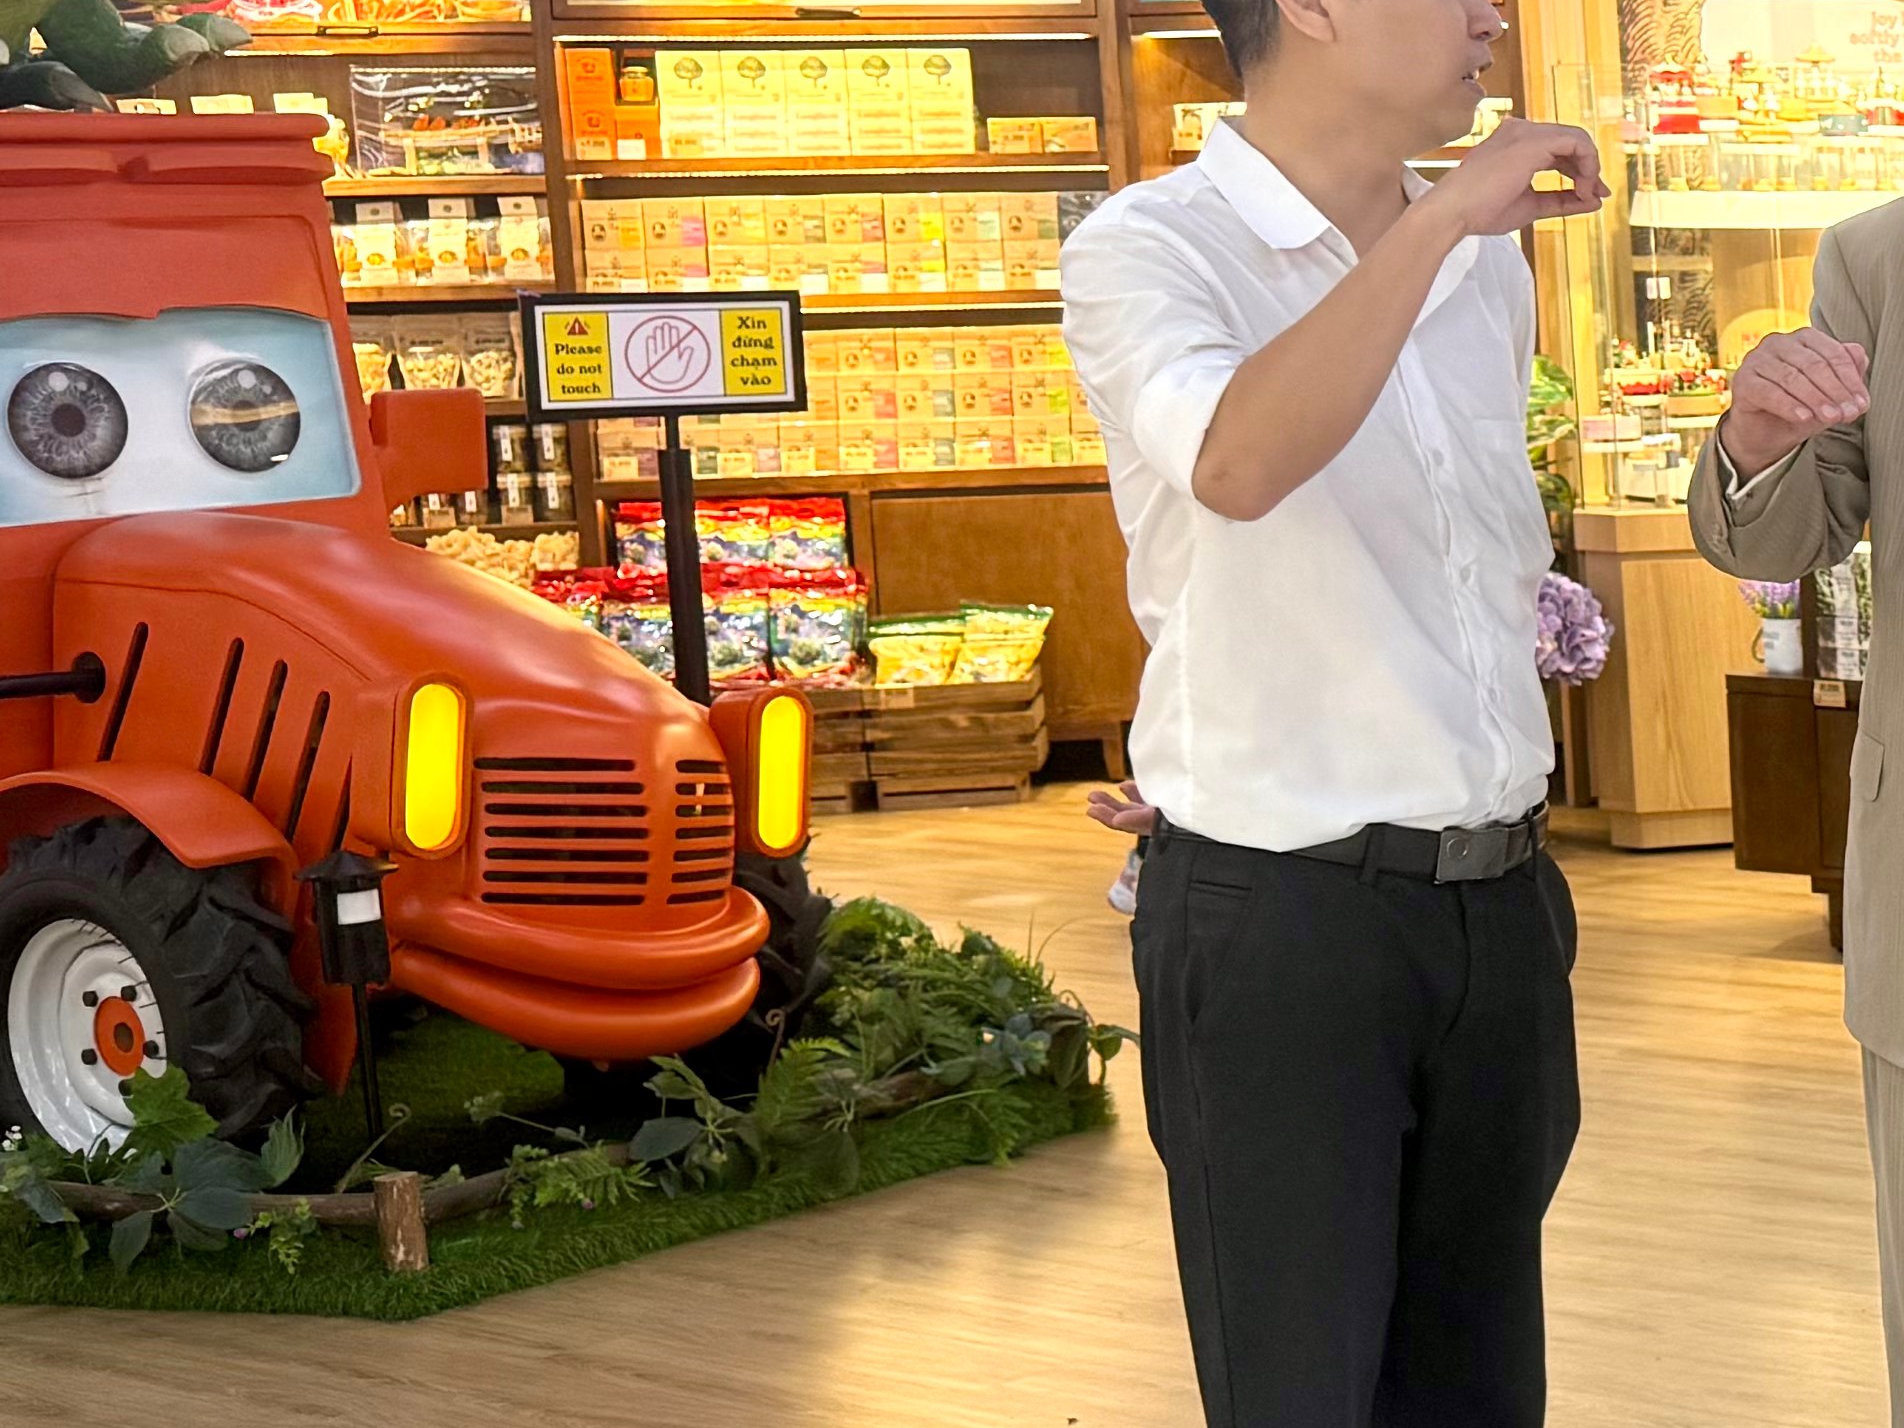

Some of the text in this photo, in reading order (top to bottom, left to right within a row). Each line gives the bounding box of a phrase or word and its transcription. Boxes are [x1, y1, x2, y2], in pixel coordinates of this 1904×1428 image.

[736, 316, 767, 330] Xin
[554, 343, 602, 355] Please
[557, 363, 602, 375] do not
[730, 356, 778, 371] chạm
[740, 372, 772, 386] vào
[561, 382, 601, 394] touch
